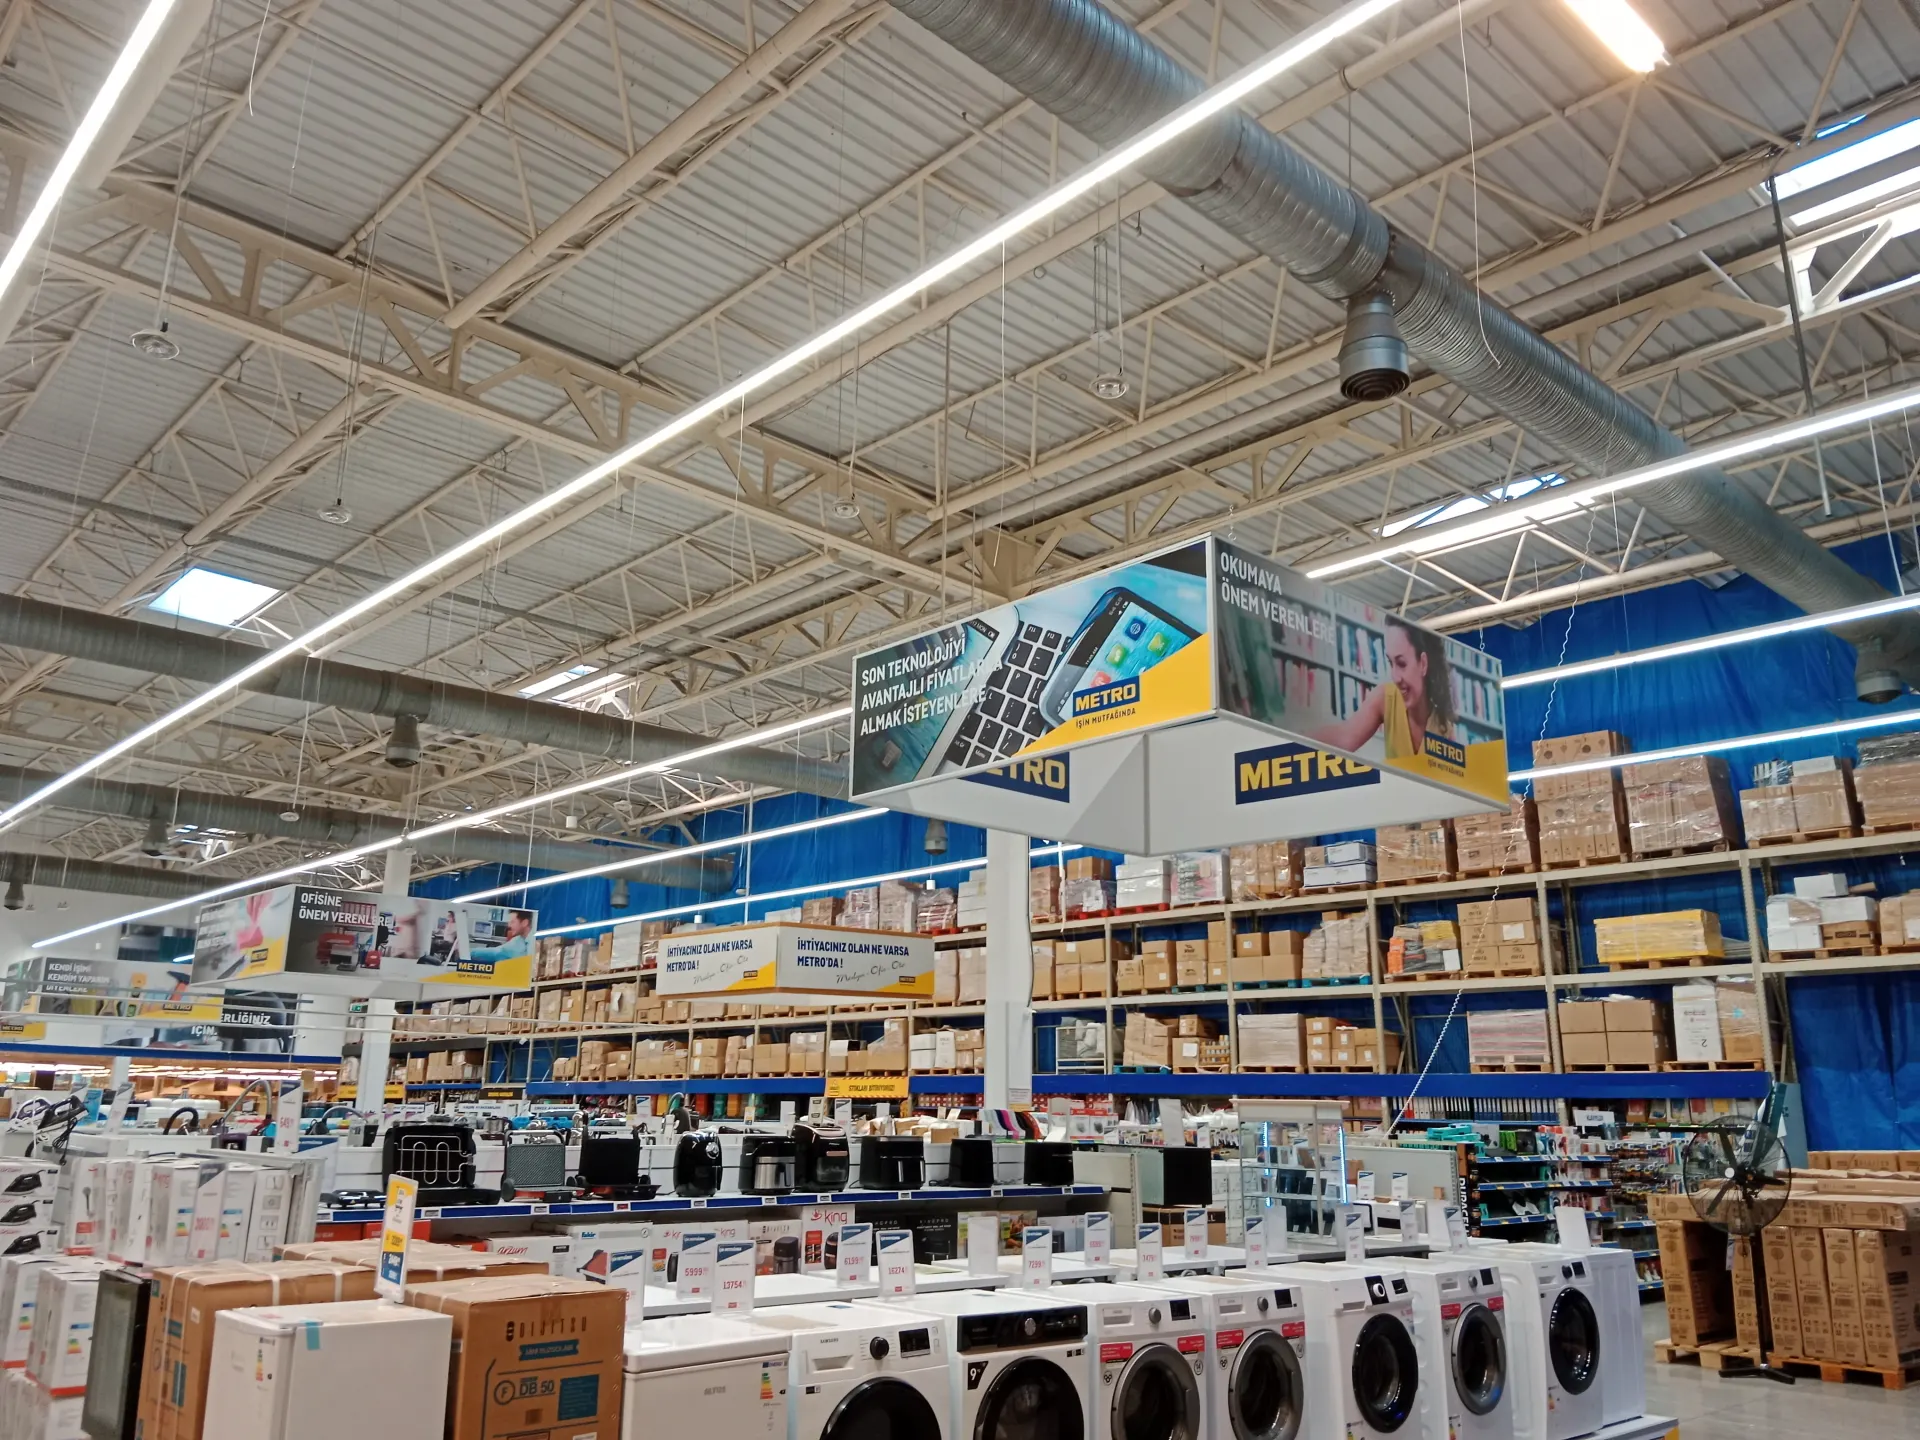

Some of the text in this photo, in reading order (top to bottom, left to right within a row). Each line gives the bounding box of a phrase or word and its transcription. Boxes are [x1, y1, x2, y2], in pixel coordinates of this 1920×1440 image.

[1220, 552, 1282, 596] OKUMAYA
[1221, 577, 1336, 647] ÖNEM VERENLERE
[862, 633, 966, 687] SON TEKNOLOJİYİ
[861, 680, 925, 712] AVANTAJLI
[1075, 683, 1136, 712] METRO
[860, 686, 987, 737] ALMAK İSTEYENLERE
[1075, 707, 1136, 729] İŞİN MUTFAĞINDA
[1426, 737, 1464, 763] METRO
[300, 891, 343, 907] OFİSİNE
[298, 906, 391, 927] ÖNEM VERENLERE
[667, 939, 753, 957] İHTİYACINIZ OLAN NE VARSA
[797, 937, 909, 957] İHTİYACINIZ OLAN NE VARSA
[458, 962, 493, 972] METRO
[666, 960, 696, 973] METRO'DA
[797, 956, 839, 968] METRO'DA
[47, 972, 77, 982] KENDİM
[824, 1209, 848, 1226] king
[970, 1368, 977, 1381] 9
[519, 1379, 556, 1396] DB 50
